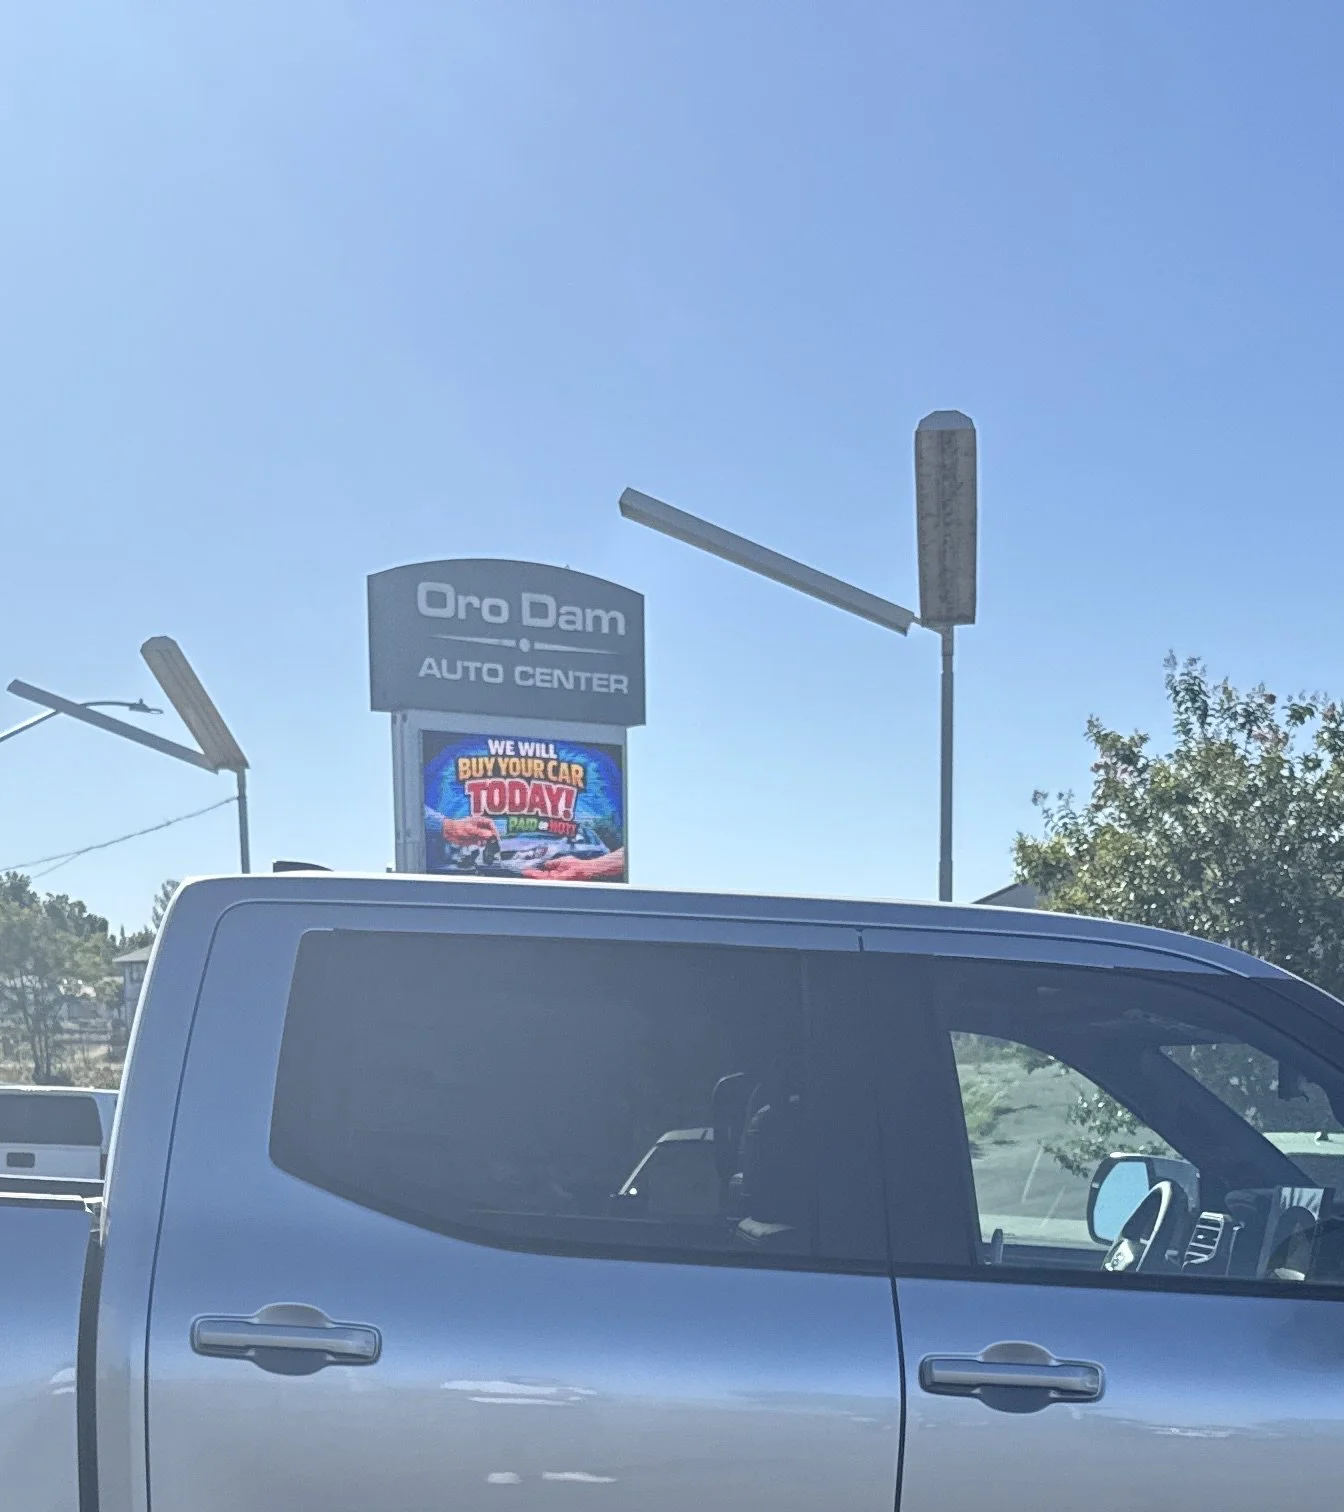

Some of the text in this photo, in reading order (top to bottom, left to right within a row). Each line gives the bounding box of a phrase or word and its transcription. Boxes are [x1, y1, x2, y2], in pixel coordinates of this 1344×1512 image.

[416, 581, 626, 636] Oro Dam
[418, 657, 629, 695] AUTO CENTER
[487, 738, 558, 759] WE WILL
[458, 758, 585, 790] BUY YOUR CAR
[465, 778, 577, 821] TODAY!
